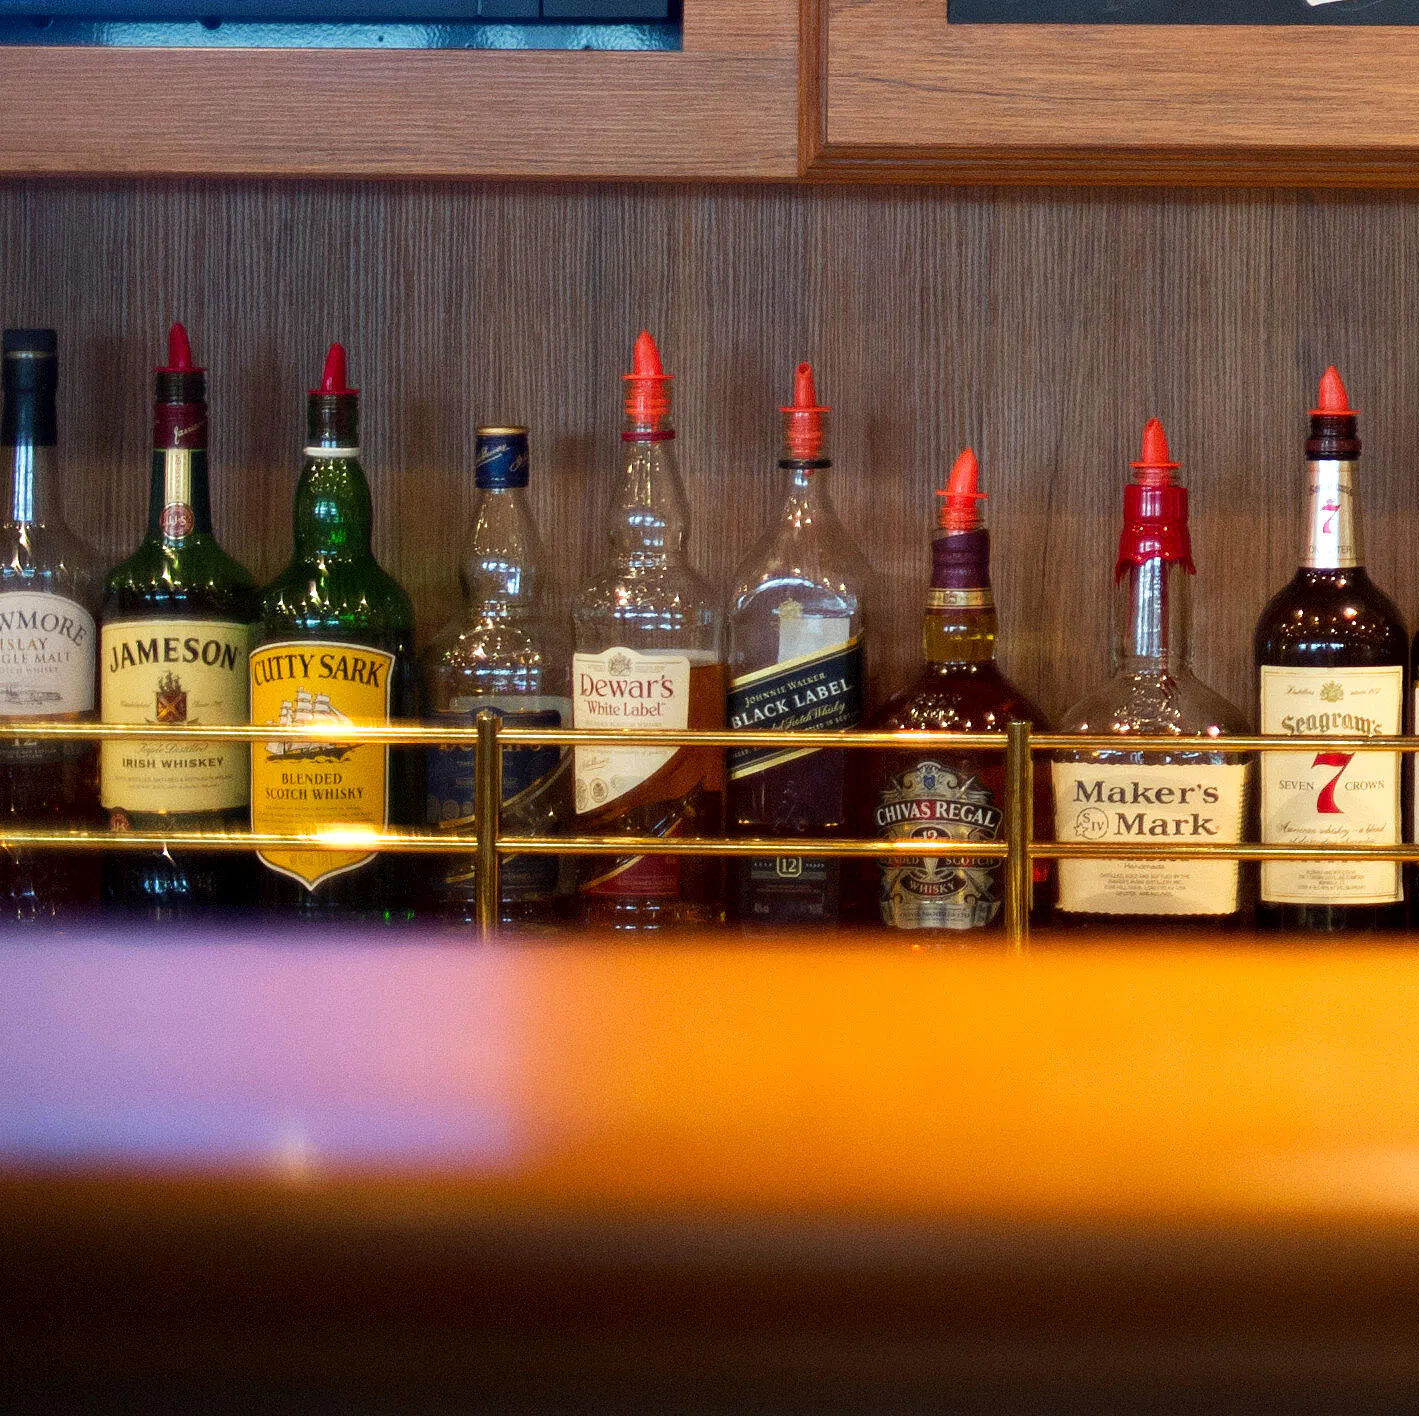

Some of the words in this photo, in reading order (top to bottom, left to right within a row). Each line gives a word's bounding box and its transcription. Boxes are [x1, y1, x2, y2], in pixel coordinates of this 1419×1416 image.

[1321, 504, 1341, 534] 7
[110, 637, 239, 674] JAMESON
[253, 654, 315, 686] CUTTY
[318, 654, 385, 688] SARK
[580, 673, 674, 699] Dewar's
[731, 698, 789, 729] BLACK
[793, 678, 852, 708] LABEL
[1281, 712, 1384, 735] Seagram's
[122, 757, 156, 769] IRISH
[161, 756, 224, 769] WHISKEY
[281, 772, 343, 786] BLENDED
[1073, 779, 1219, 804] Maker's
[1279, 779, 1314, 790] SEVEN
[1345, 779, 1385, 790] CROWN
[1311, 751, 1356, 814] 7
[265, 787, 307, 800] SCOTCH
[312, 786, 365, 800] WHISKY
[877, 802, 931, 826] CHIVAS
[935, 801, 996, 828] REGAL
[1114, 812, 1218, 836] Mark
[781, 858, 799, 873] 12
